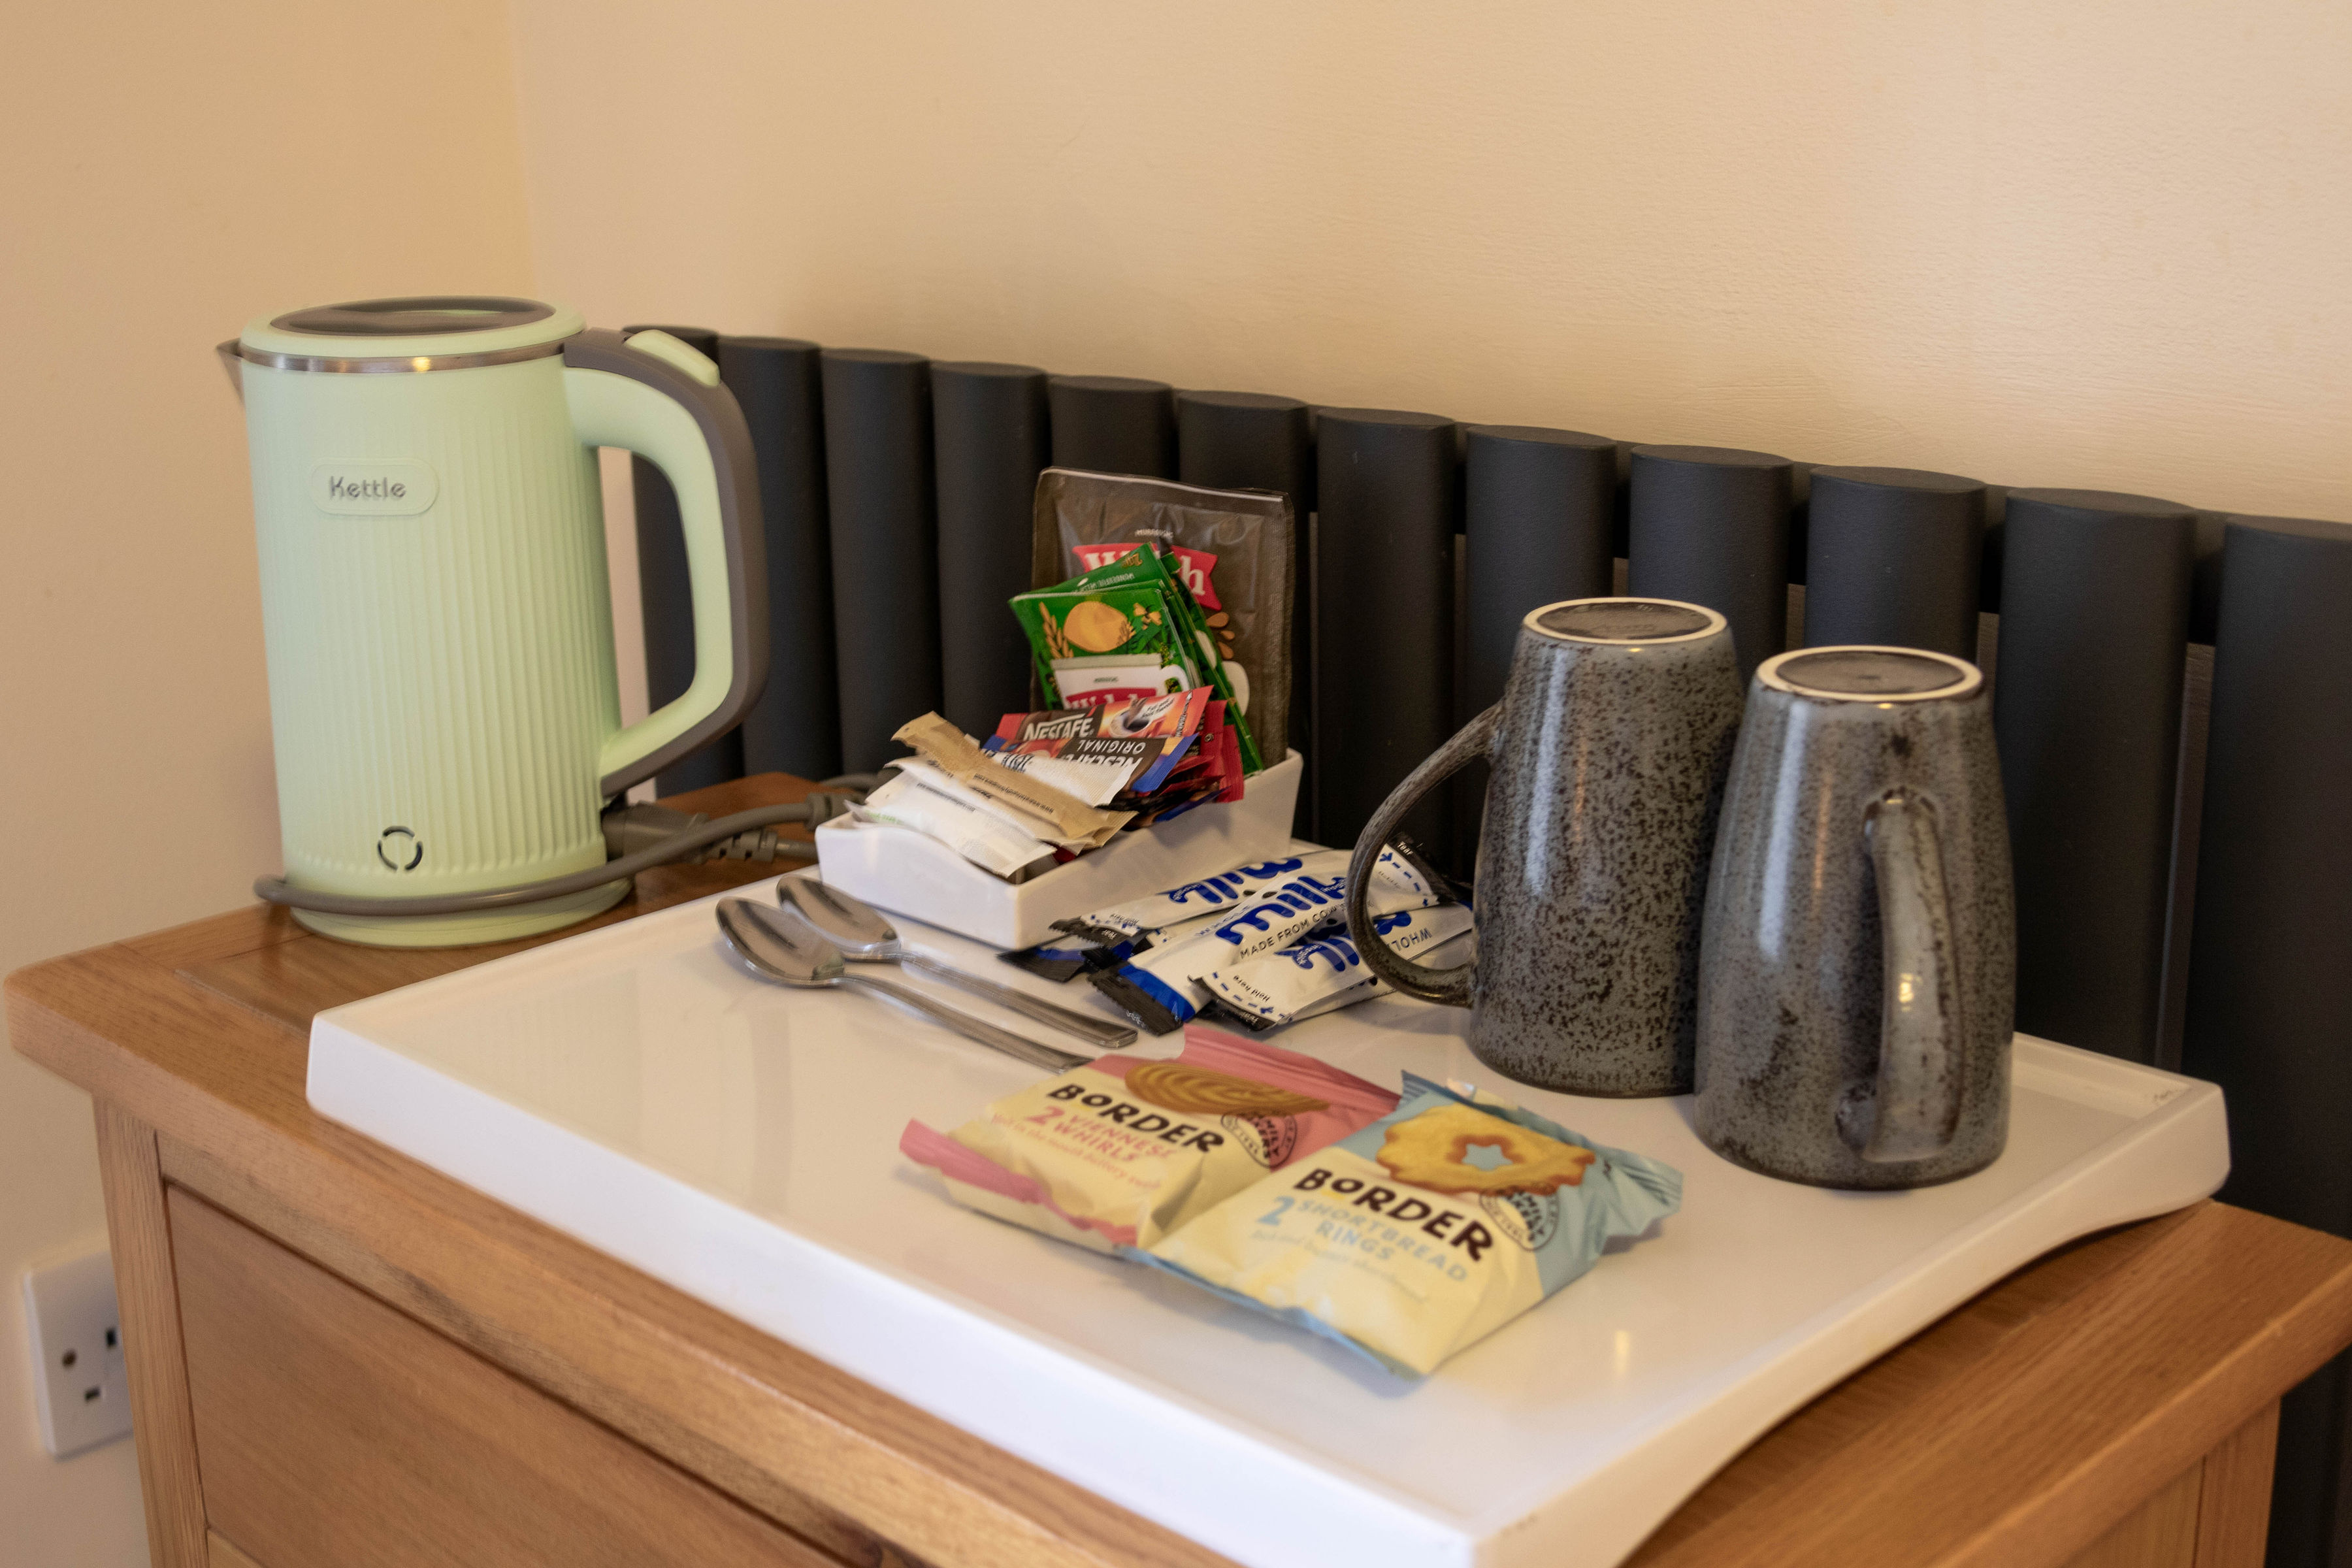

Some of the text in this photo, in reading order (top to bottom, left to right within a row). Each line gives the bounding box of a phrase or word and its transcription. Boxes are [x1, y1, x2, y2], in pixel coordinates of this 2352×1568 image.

[329, 476, 406, 498] Kettle
[1077, 739, 1146, 755] ORIGINAL
[1397, 841, 1414, 856] Tear
[1215, 875, 1348, 946] milk
[1239, 936, 1276, 959] MADE
[1277, 919, 1310, 942] FROM
[1386, 927, 1433, 952] WHOL
[1233, 974, 1271, 1003] Hold here
[1024, 1105, 1066, 1126] 2
[1046, 1083, 1225, 1153] BORDER
[1053, 1122, 1140, 1162] WHIRLS
[1292, 1168, 1494, 1263] BORDER
[1256, 1194, 1296, 1228] 2
[1296, 1198, 1469, 1282] SHORTBREAD
[1315, 1219, 1396, 1262] RINGS
